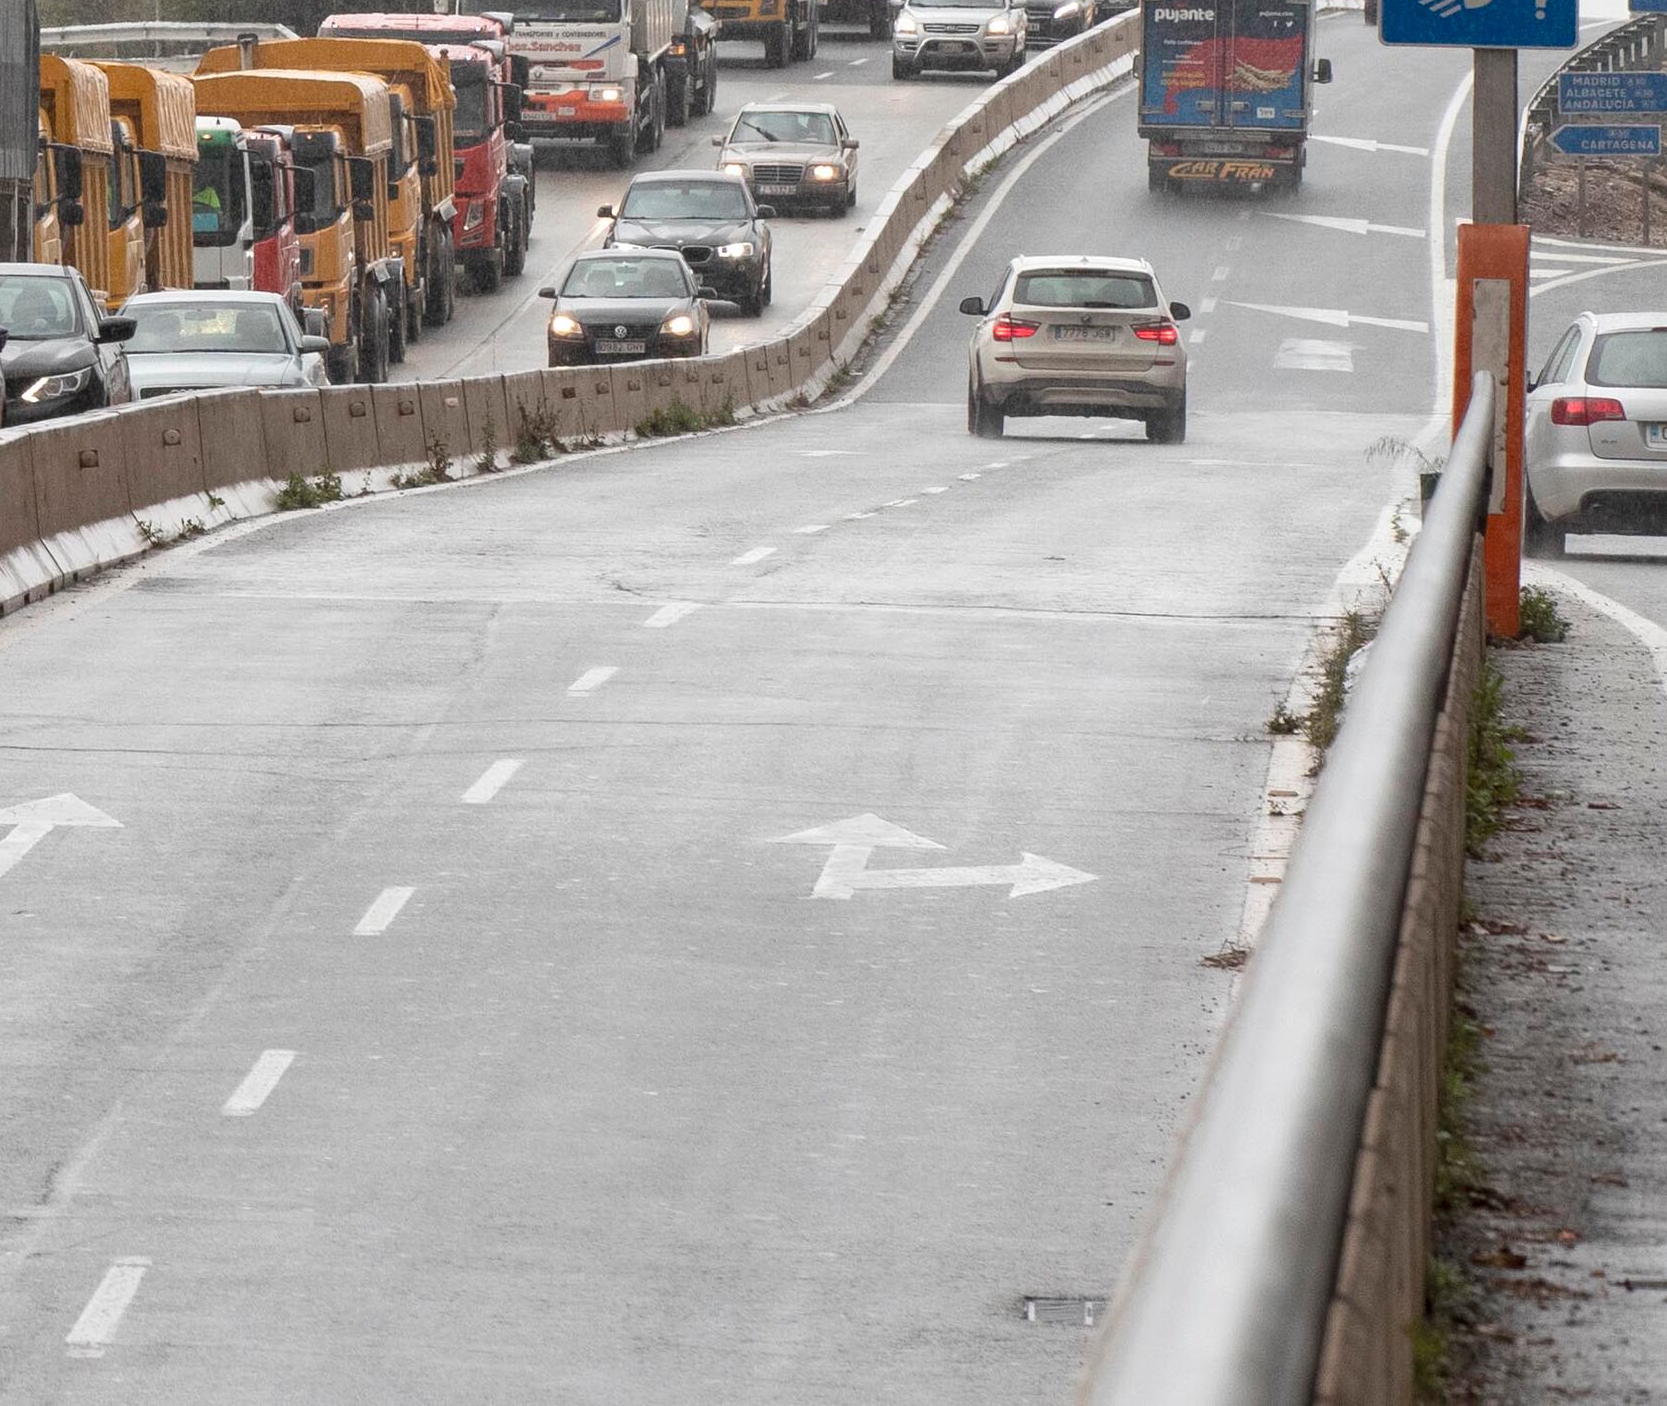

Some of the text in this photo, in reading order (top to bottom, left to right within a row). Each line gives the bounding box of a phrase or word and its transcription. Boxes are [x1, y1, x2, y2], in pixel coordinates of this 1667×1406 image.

[1154, 8, 1215, 24] pujante
[1572, 77, 1620, 86] MADRID
[1566, 89, 1627, 98] ALBACETE
[1581, 140, 1655, 150] CARTAGENA
